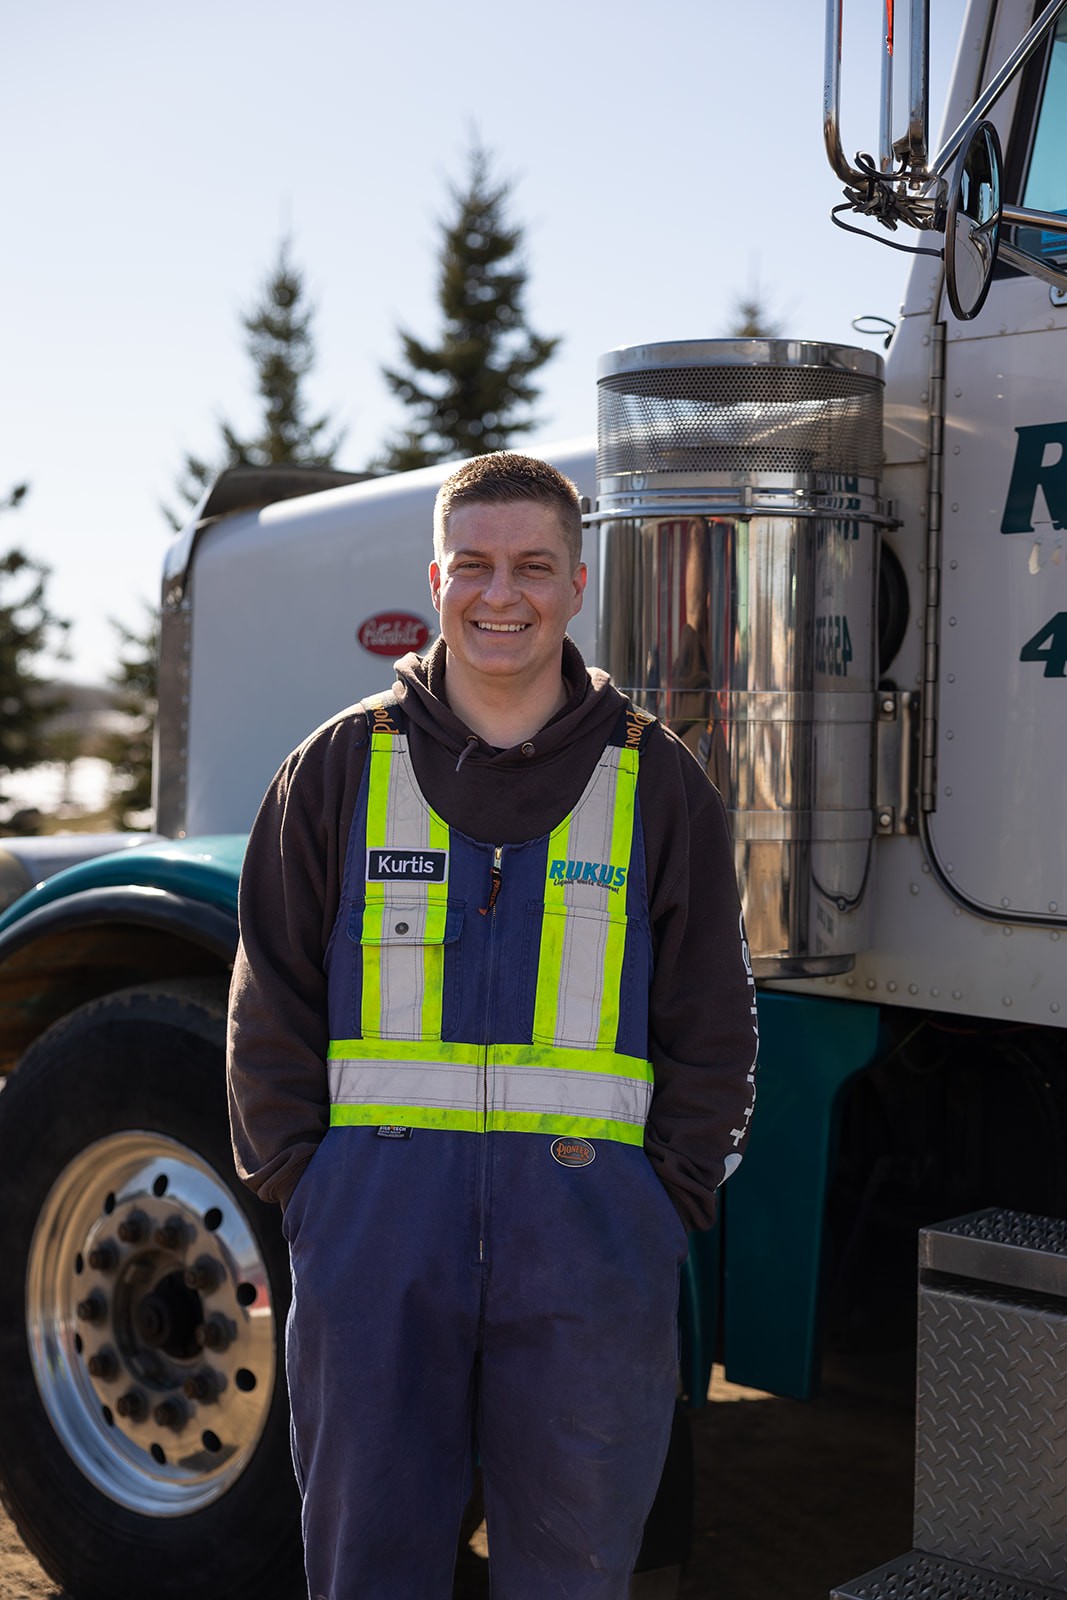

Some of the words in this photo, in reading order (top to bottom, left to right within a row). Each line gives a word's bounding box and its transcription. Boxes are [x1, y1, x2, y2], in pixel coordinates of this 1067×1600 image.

[378, 856, 434, 874] Kurtis
[549, 860, 627, 887] RUKUS
[556, 1142, 590, 1159] PIONEER
